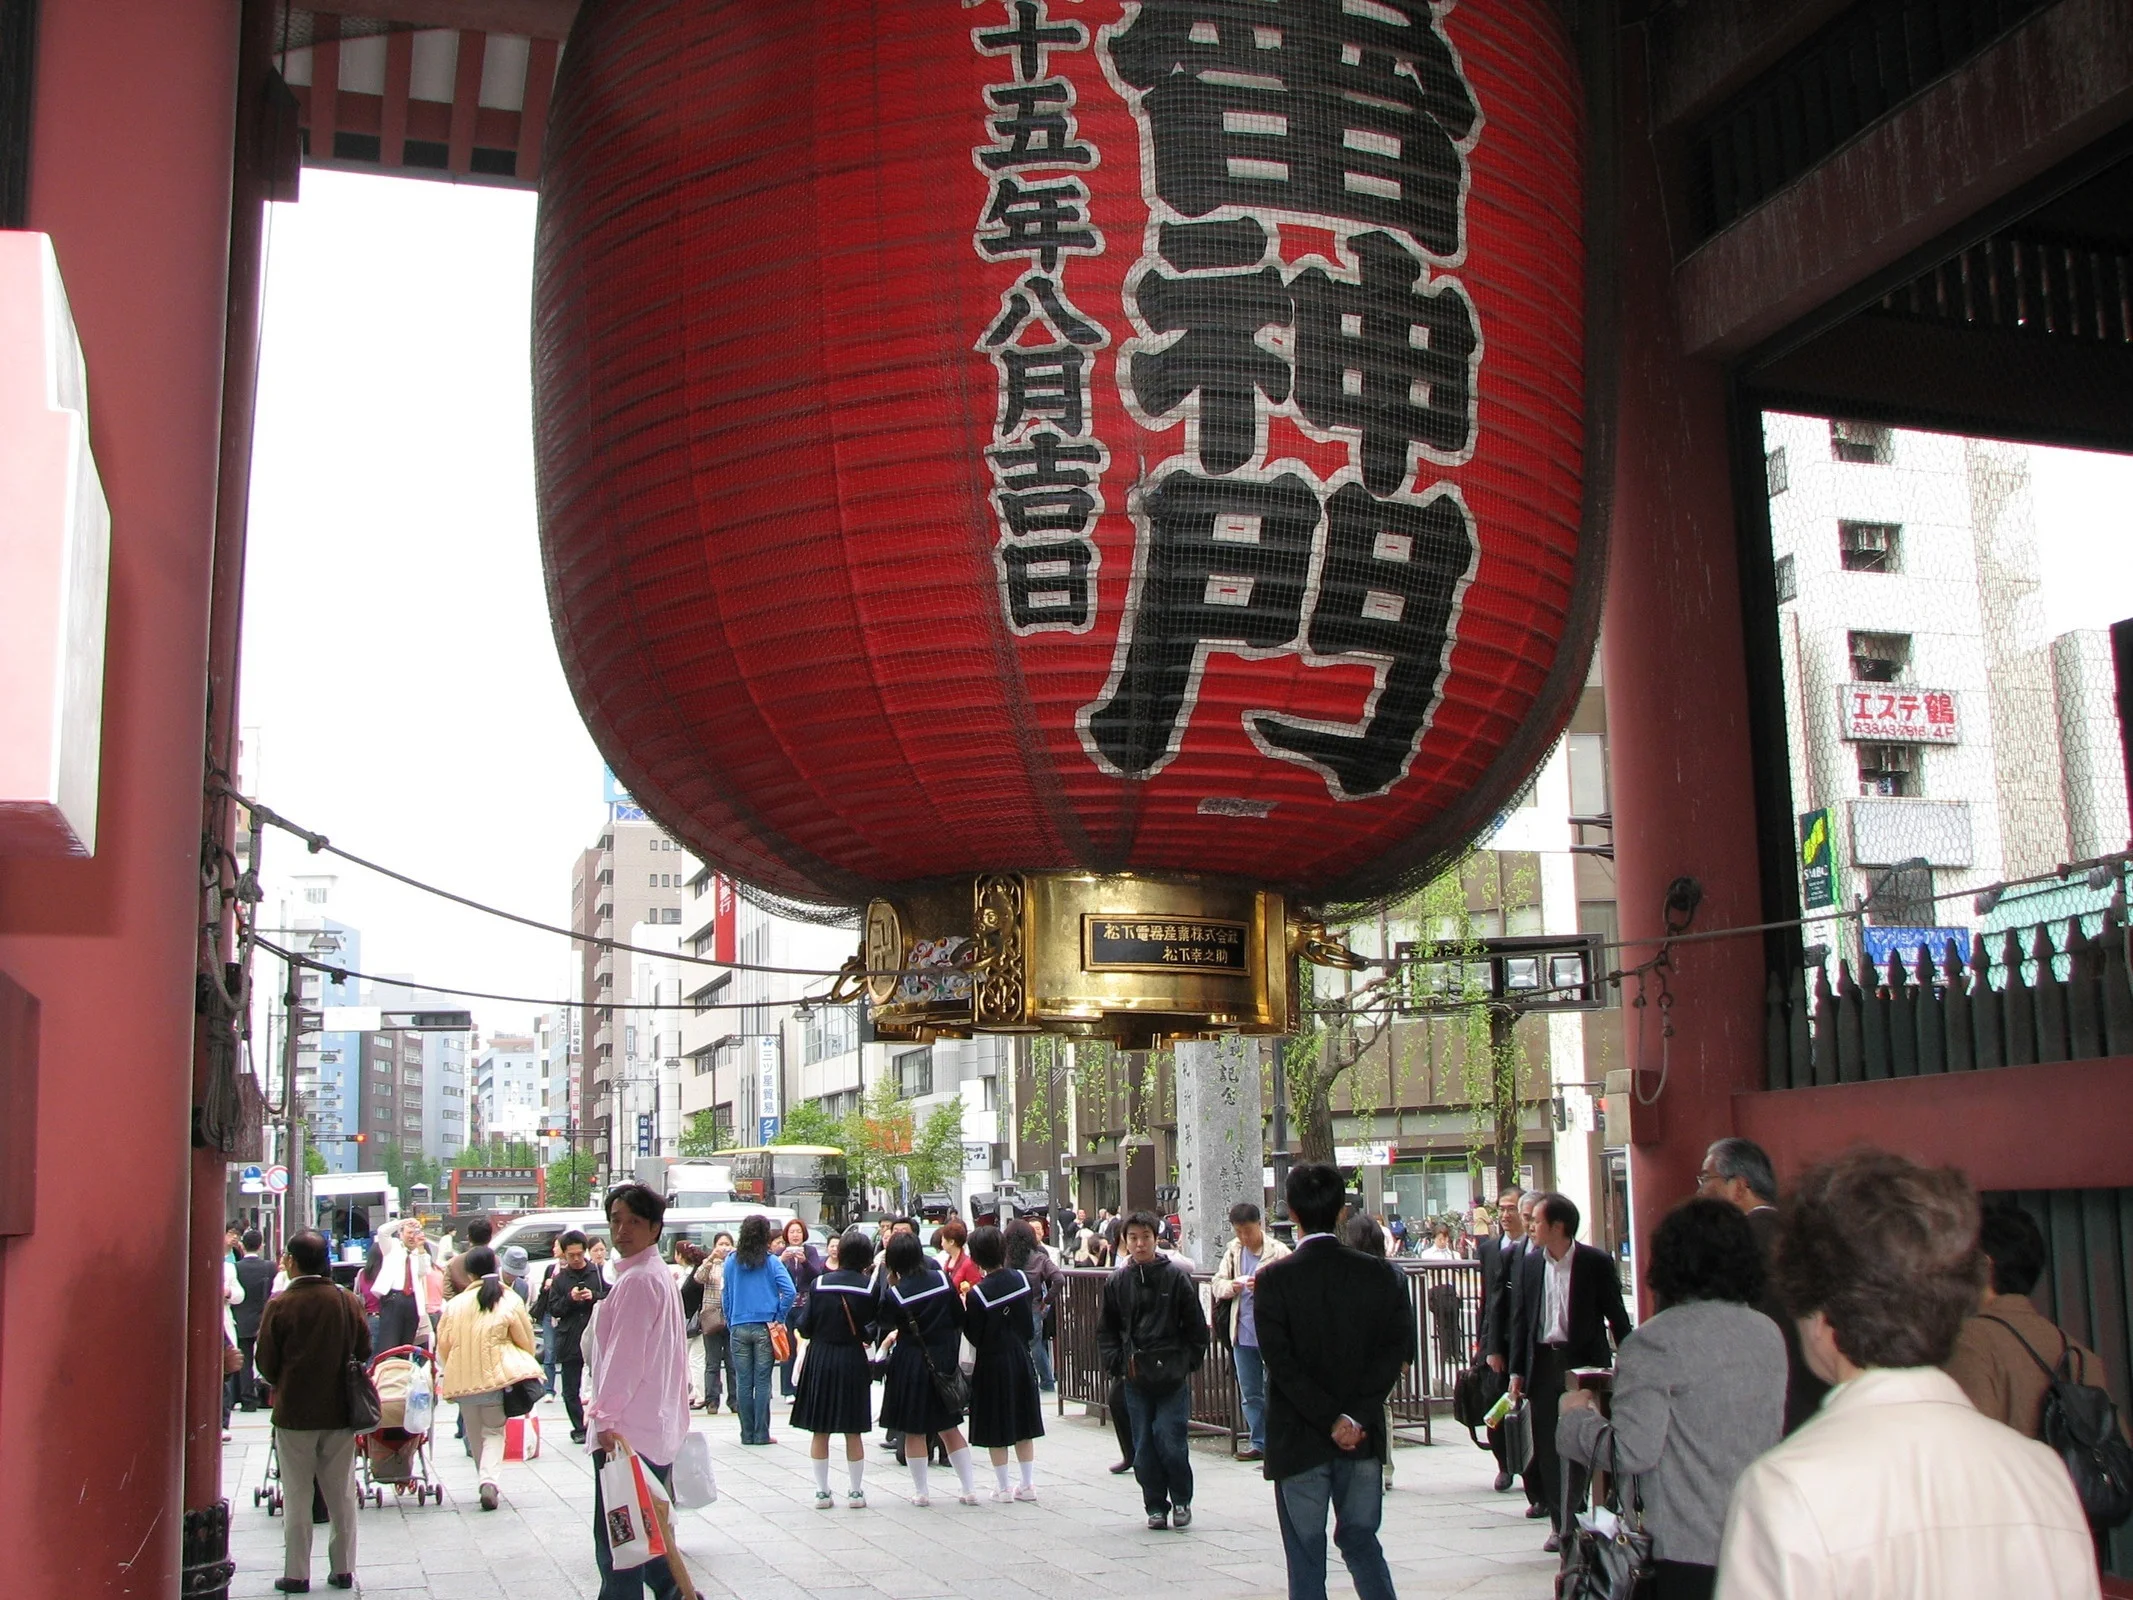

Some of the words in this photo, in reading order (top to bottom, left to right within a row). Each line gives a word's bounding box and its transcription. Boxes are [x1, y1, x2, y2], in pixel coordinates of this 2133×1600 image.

[970, 0, 1112, 637] 十五年八月吉日
[1853, 692, 1955, 724] エステ鶴
[1803, 864, 1829, 880] SMBC
[1103, 922, 1239, 945] 松下電器産業株式会社
[1162, 946, 1228, 964] 松下幸之助
[763, 1050, 774, 1114] 三ツ星貿易
